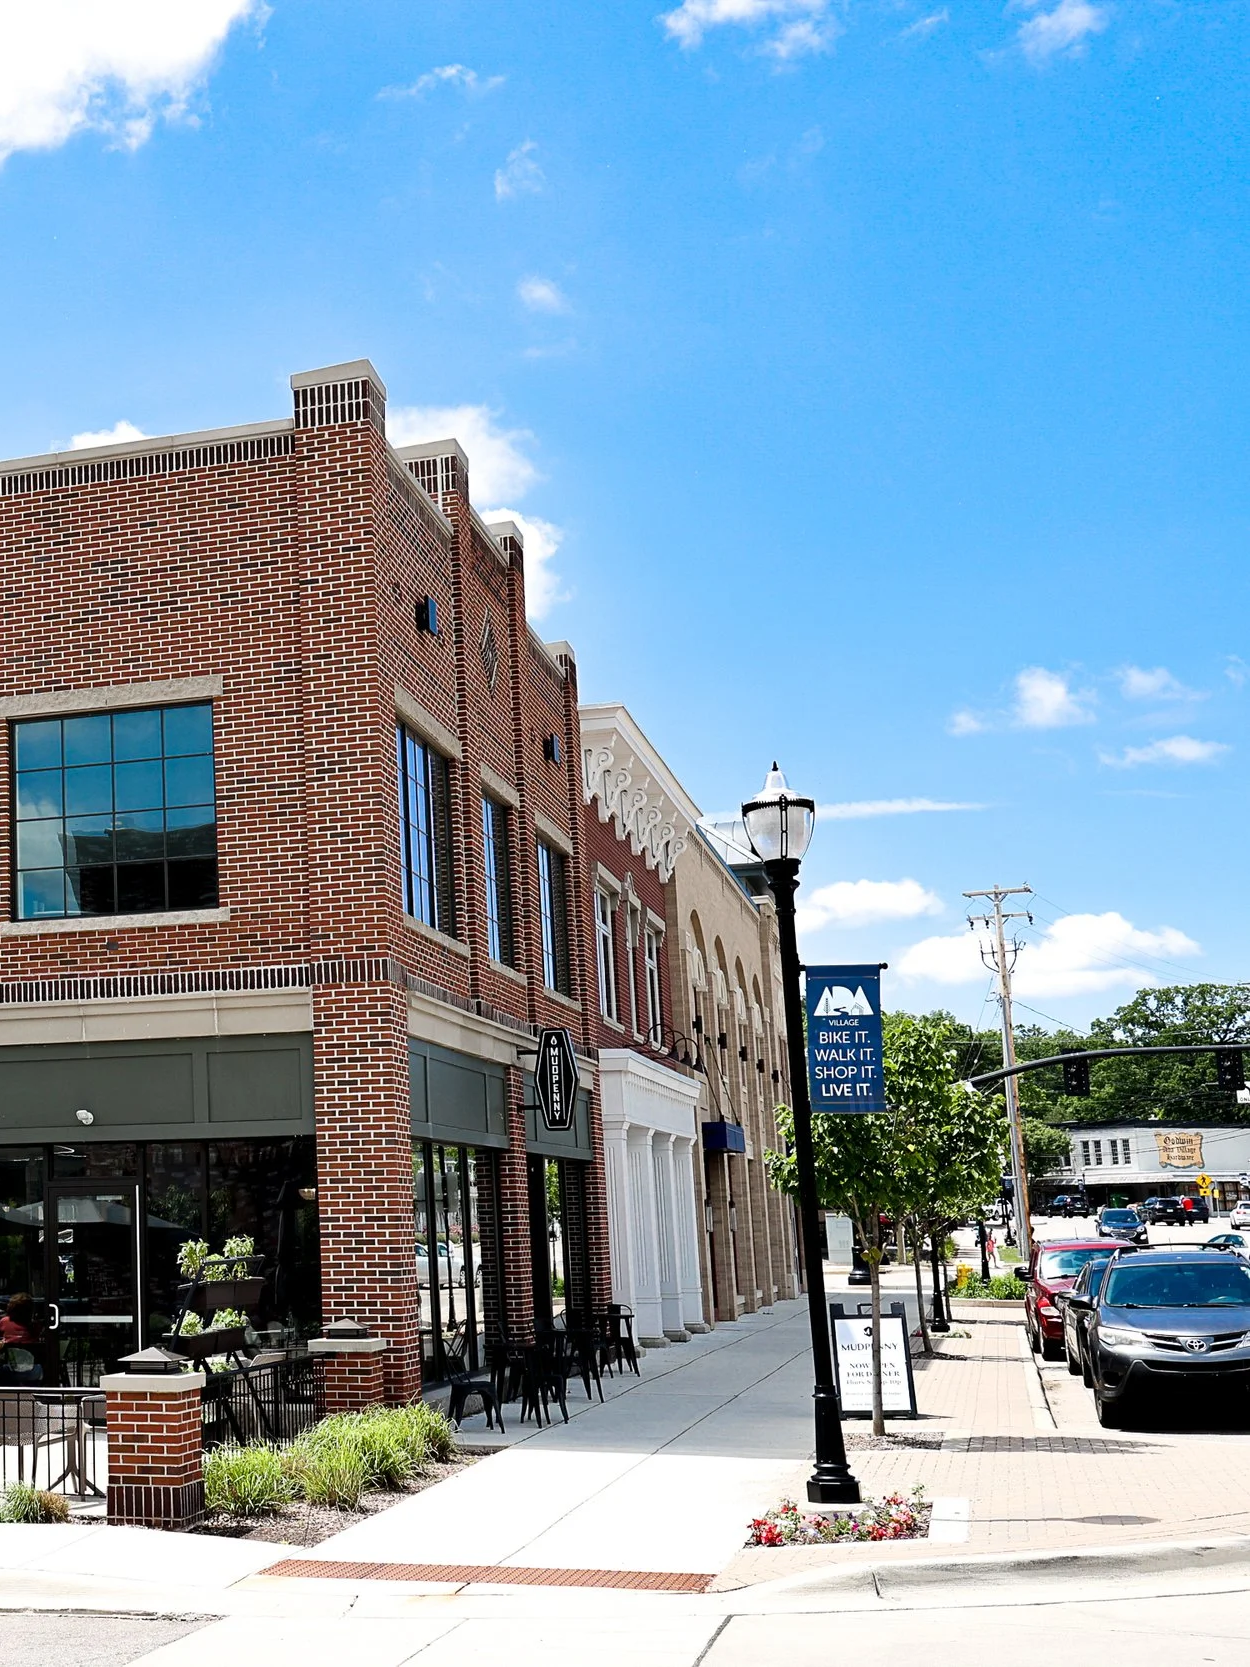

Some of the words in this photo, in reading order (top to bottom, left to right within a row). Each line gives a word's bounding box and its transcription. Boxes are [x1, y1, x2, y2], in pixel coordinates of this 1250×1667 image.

[819, 1031, 851, 1044] BIKE
[855, 1031, 870, 1043] IT.
[814, 1049, 856, 1061] WALK
[860, 1048, 876, 1060] IT.
[815, 1066, 857, 1079] SHOP
[861, 1066, 877, 1078] IT.
[550, 1047, 560, 1120] MUDPENNY
[822, 1083, 852, 1096] LIVE
[856, 1083, 872, 1096] IT.
[841, 1343, 898, 1351] MUDPNY
